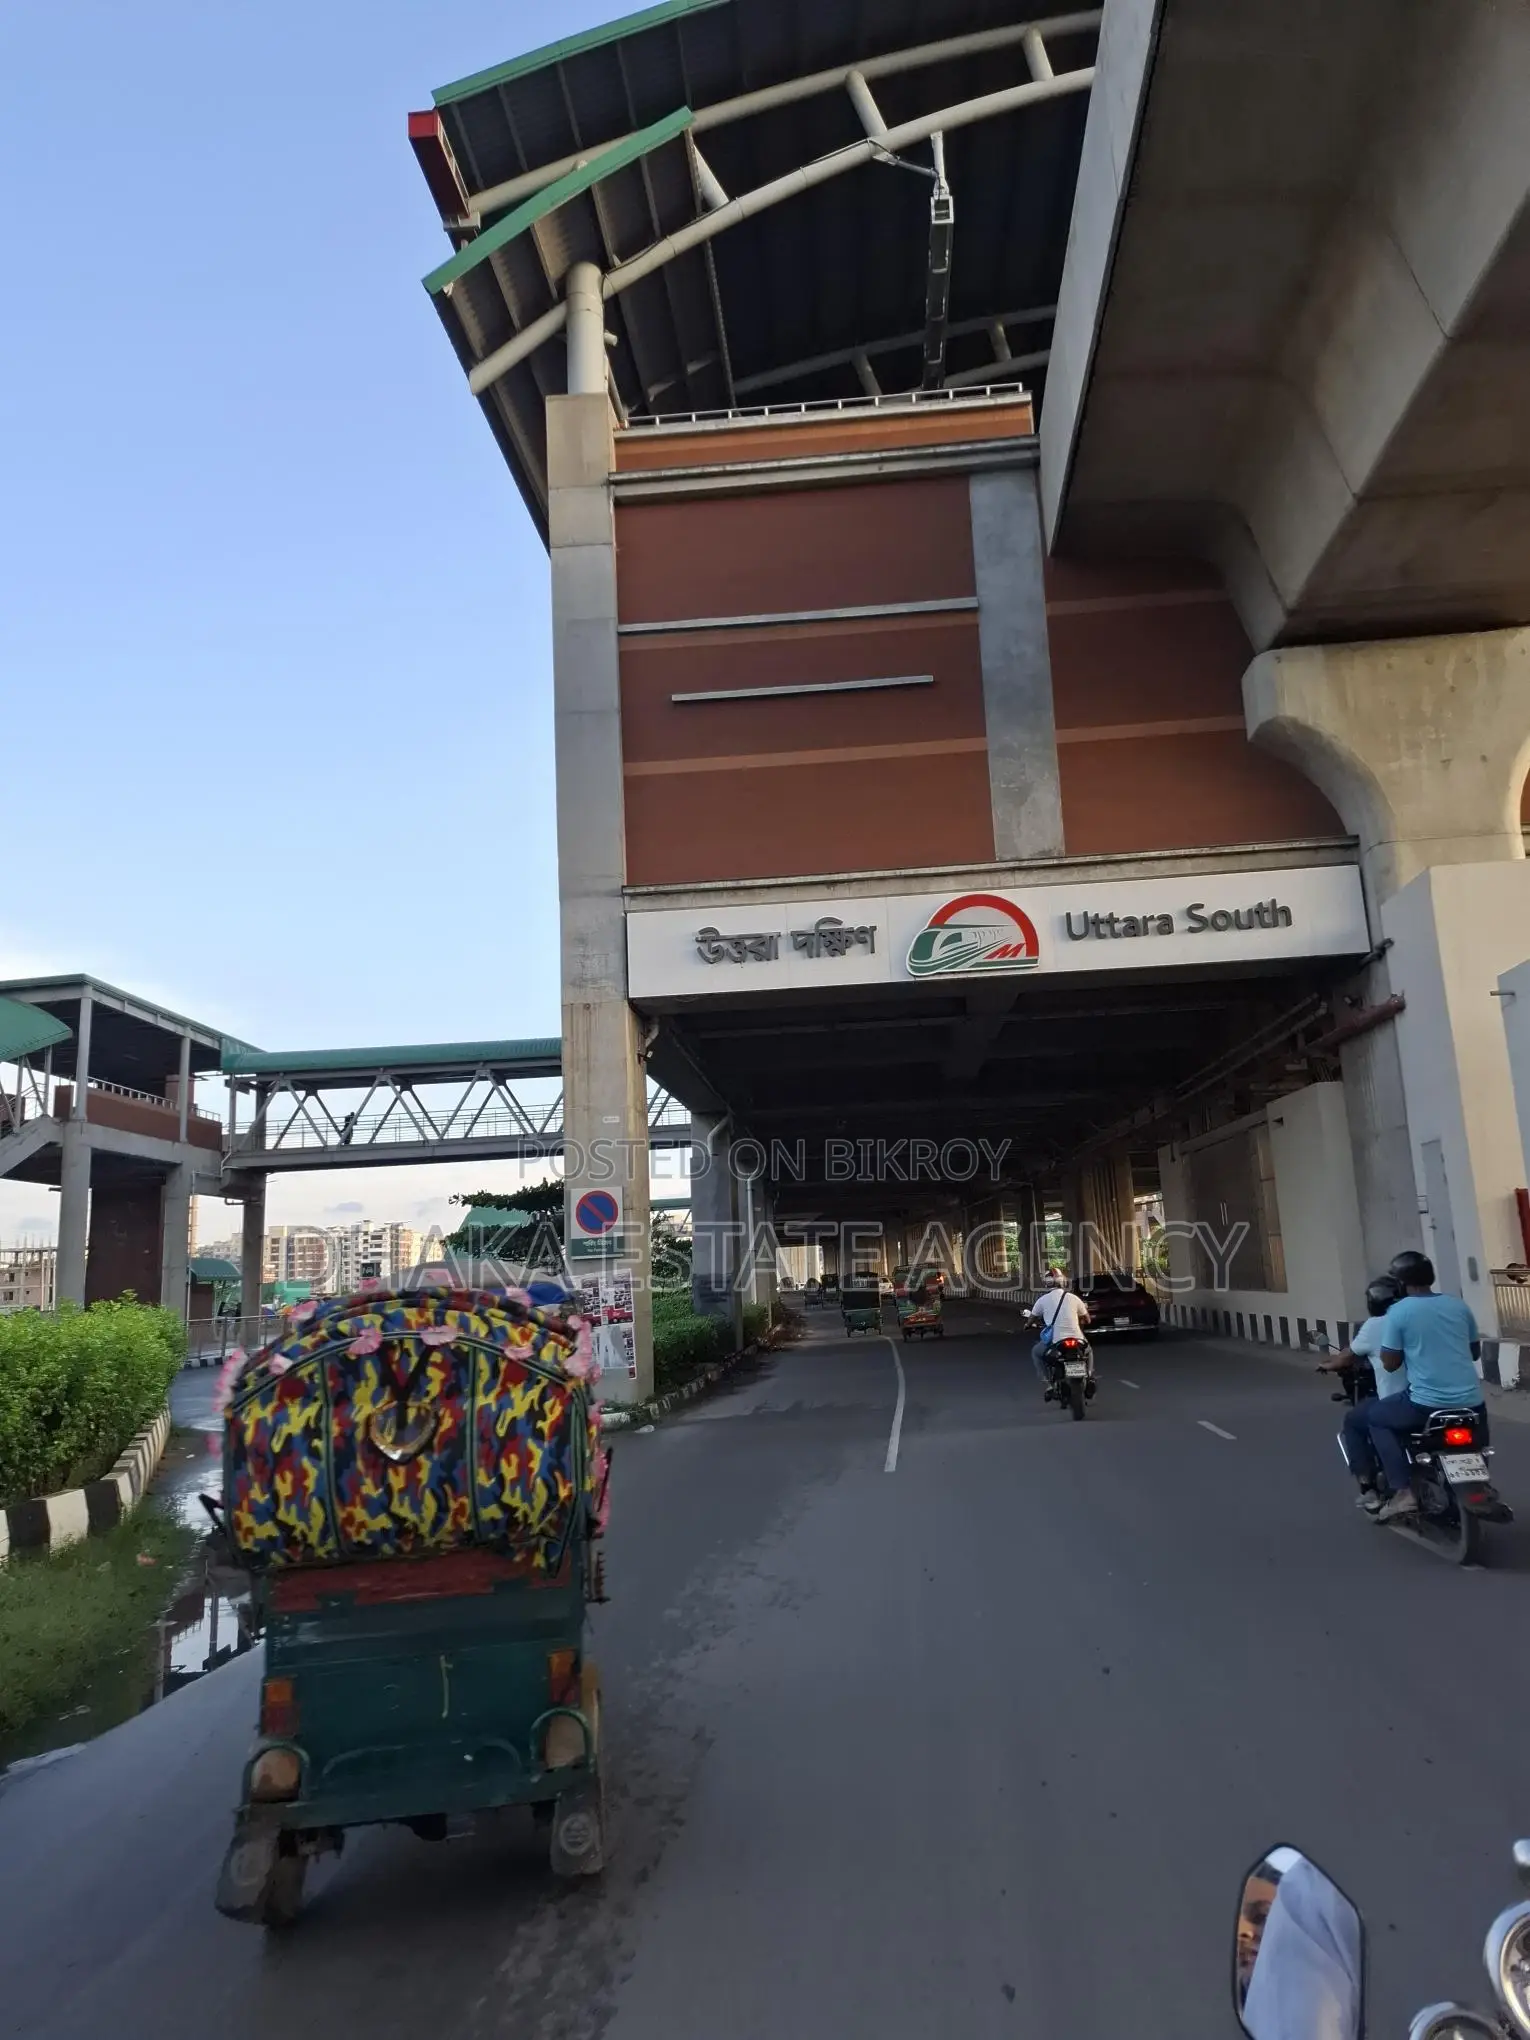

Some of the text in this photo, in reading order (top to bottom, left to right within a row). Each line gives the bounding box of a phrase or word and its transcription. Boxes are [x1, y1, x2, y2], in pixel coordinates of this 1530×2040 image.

[695, 916, 877, 965] উত্তরা দক্ষিণ
[1066, 898, 1293, 942] Uttara South
